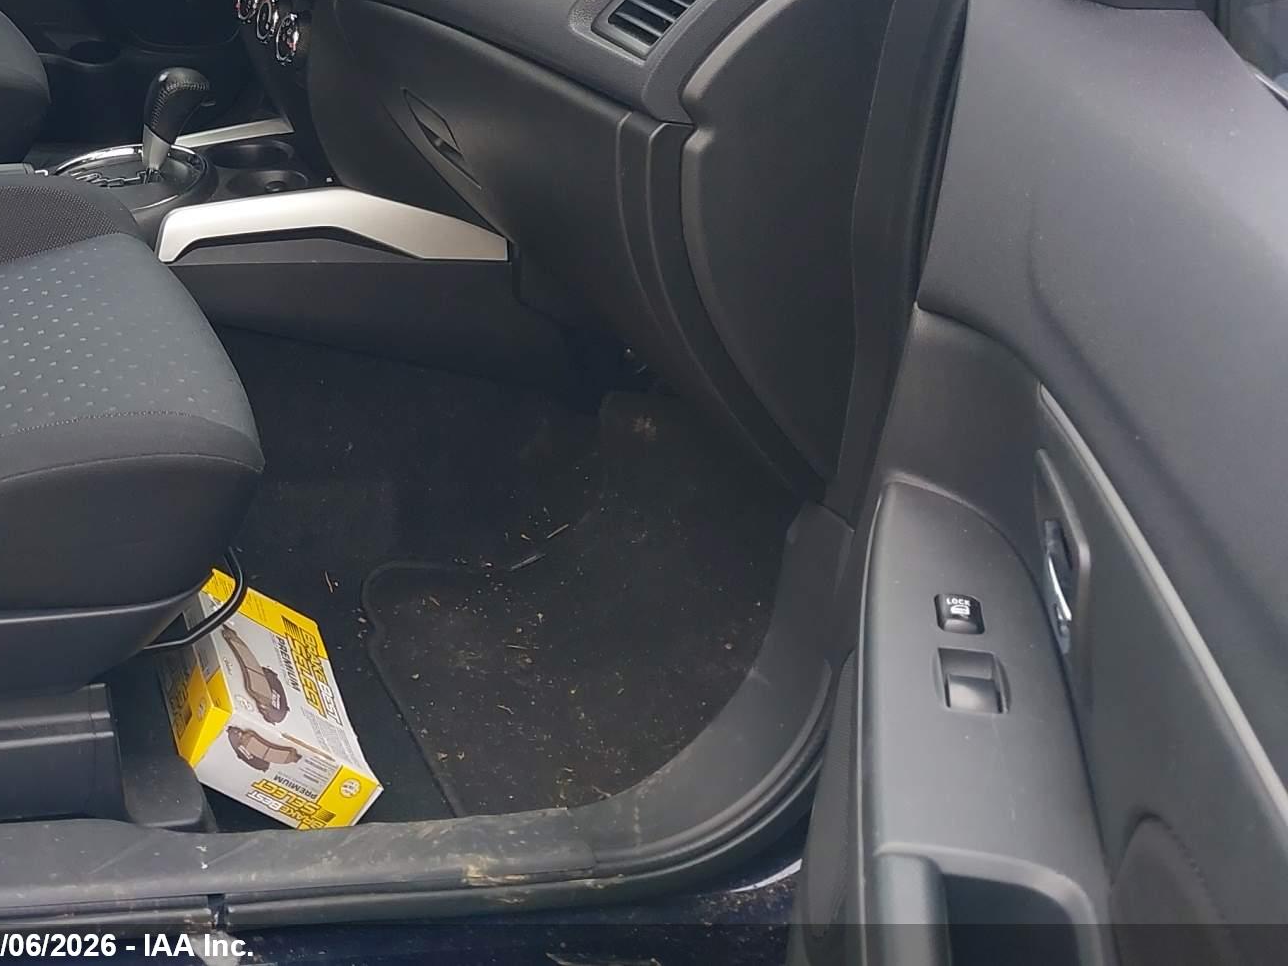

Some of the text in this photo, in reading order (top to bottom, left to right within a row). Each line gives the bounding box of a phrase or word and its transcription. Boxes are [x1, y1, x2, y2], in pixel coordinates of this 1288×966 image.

[946, 597, 971, 606] LOCK
[275, 636, 301, 692] PREMIUM
[285, 632, 327, 718] SELECT
[252, 779, 320, 815] SELECT
[274, 774, 317, 800] PREMIUM
